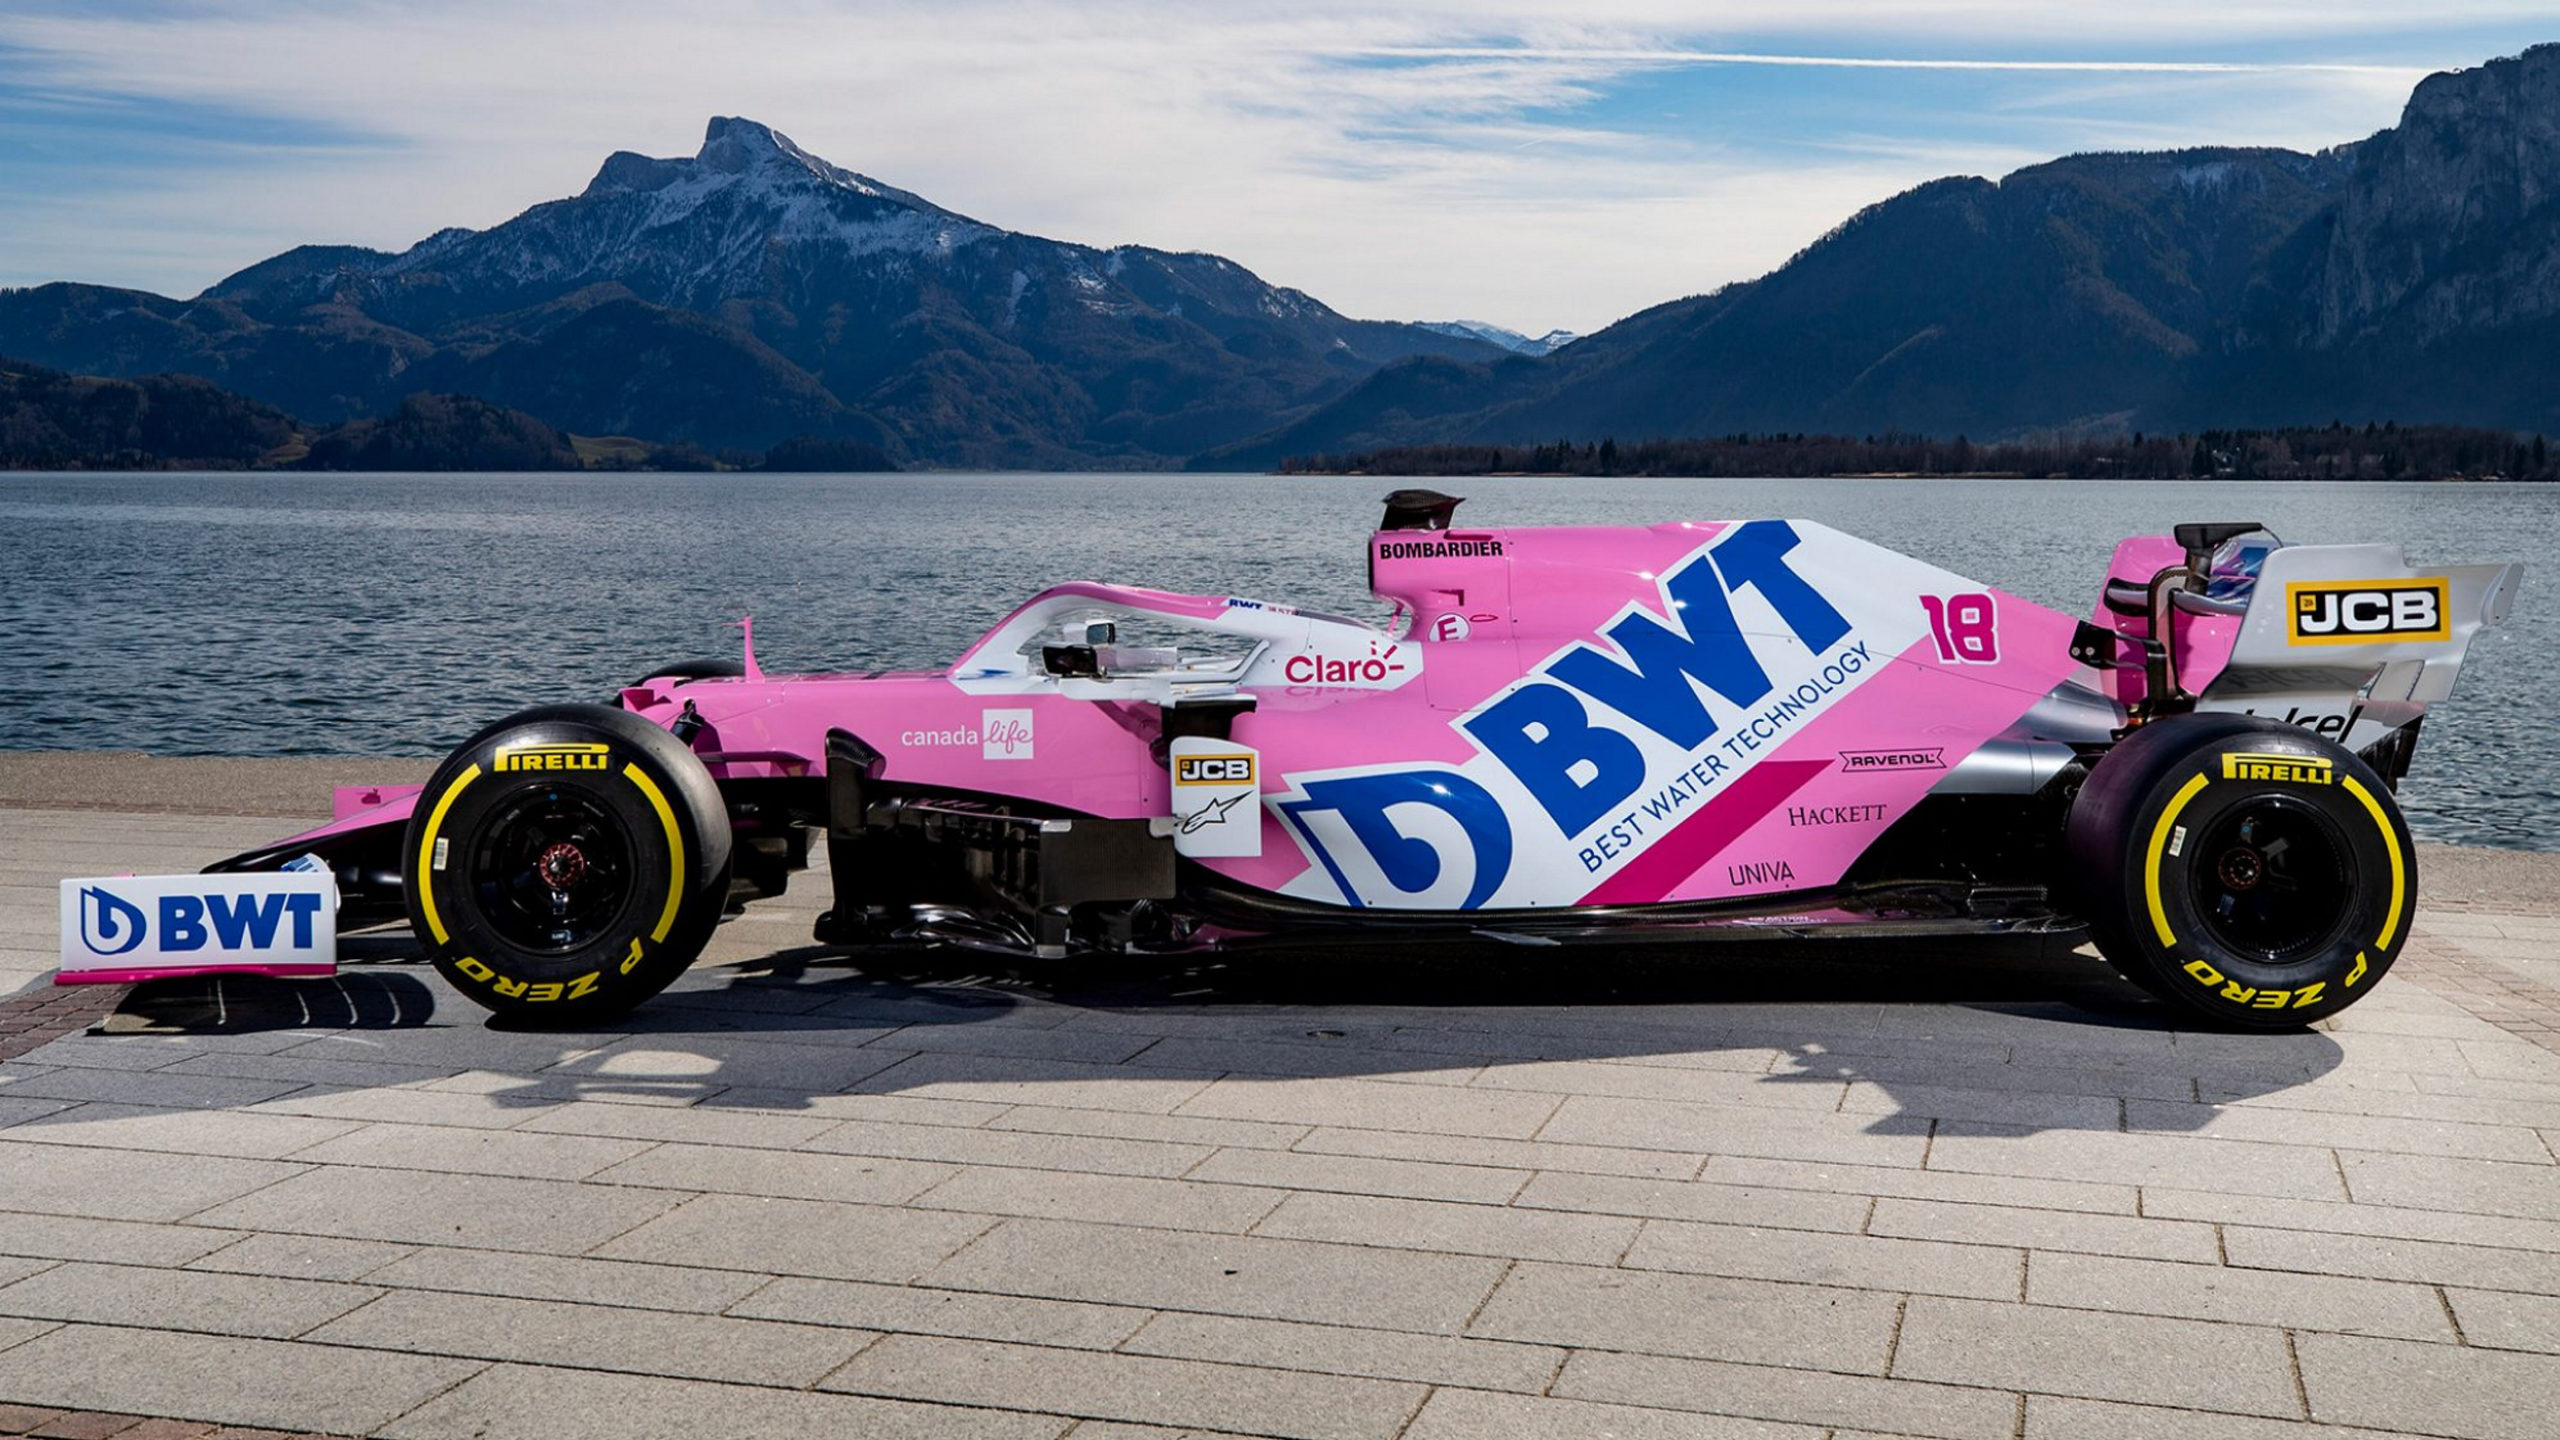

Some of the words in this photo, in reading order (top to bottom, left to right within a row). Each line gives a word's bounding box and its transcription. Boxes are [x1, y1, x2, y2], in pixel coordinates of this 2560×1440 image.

[1380, 541, 1503, 559] BOMBARDIER
[1437, 617, 1460, 641] E
[1919, 594, 1997, 661] 18
[2300, 591, 2437, 632] JCB
[1285, 653, 1388, 683] Claro
[1464, 520, 1851, 840] BWT
[901, 724, 978, 746] canada
[983, 719, 1033, 754] life
[494, 743, 609, 771] PIRELLI
[1181, 760, 1249, 780] JCB
[1579, 812, 1639, 873] BEST
[1643, 754, 1726, 820] WATER
[1723, 641, 1870, 758] TECHNOLOGY
[1851, 754, 1937, 768] RAVENOL
[2222, 752, 2333, 785] PIRELLI
[1788, 804, 1888, 826] HACKETT
[1728, 861, 1795, 886] UNIVA
[159, 893, 321, 952] BWT
[620, 937, 644, 975] P
[2344, 951, 2368, 988] P
[455, 956, 600, 1002] ZERO
[2183, 960, 2327, 1008] ZERO
